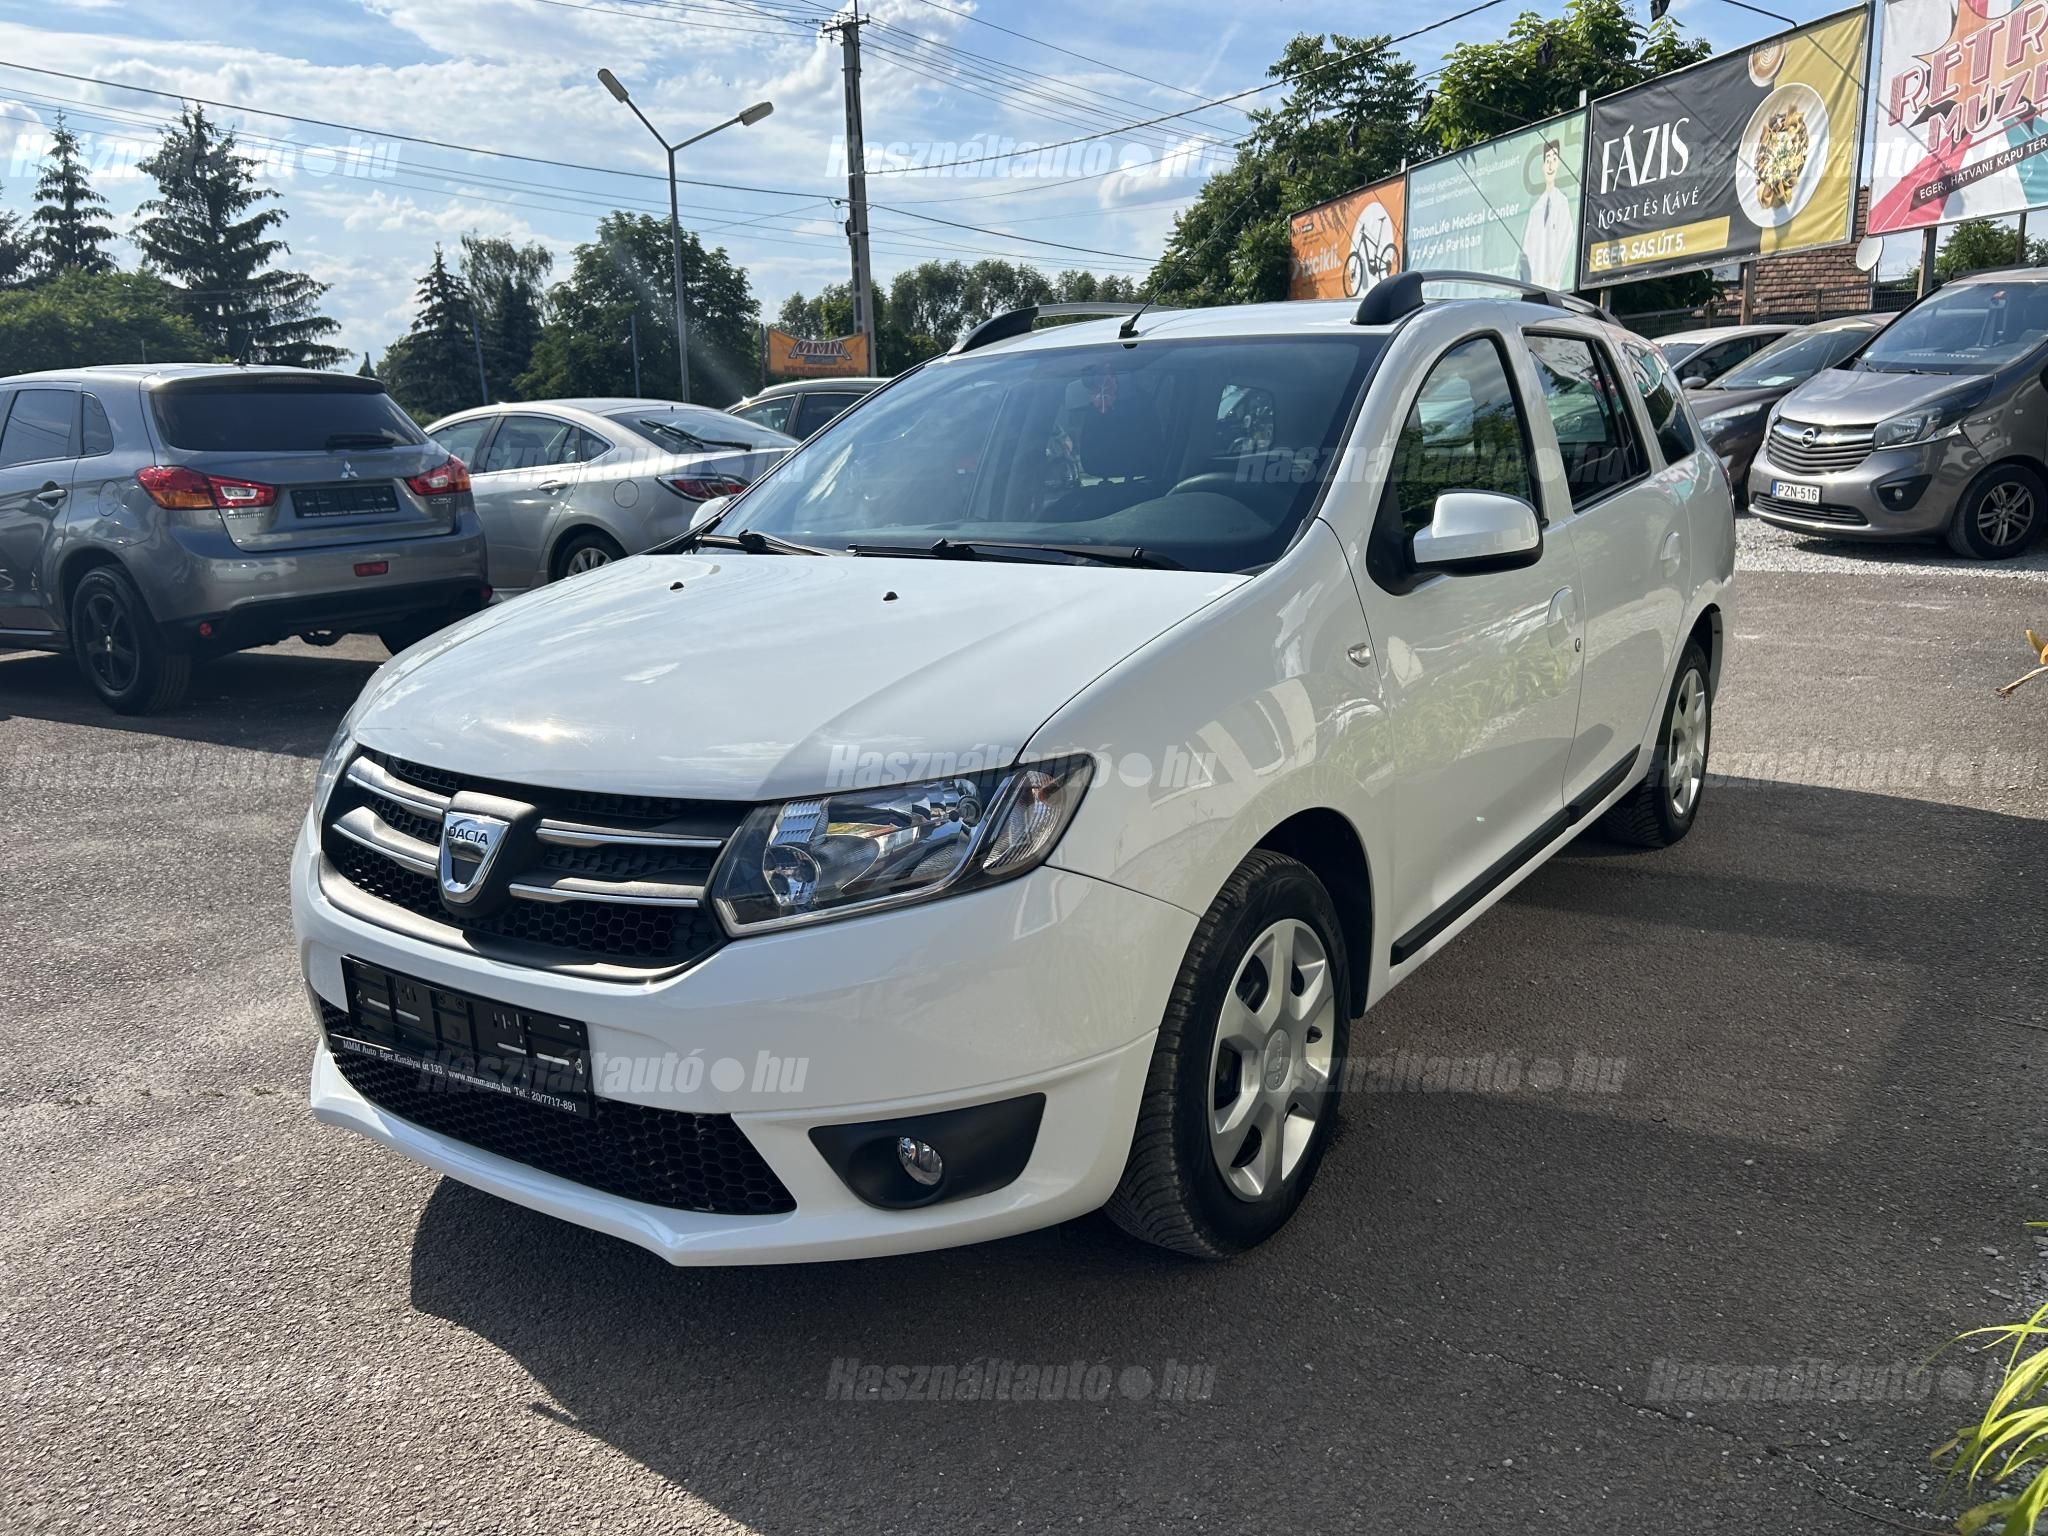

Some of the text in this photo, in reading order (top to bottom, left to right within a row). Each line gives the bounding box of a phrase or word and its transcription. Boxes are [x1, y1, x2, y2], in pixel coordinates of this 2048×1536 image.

[1600, 117, 1690, 195] FÁZIS
[1919, 180, 1947, 200] EGER,
[1950, 160, 1994, 186] HATVANI
[1996, 147, 2024, 167] KAPU
[1412, 202, 1520, 241] TritonLife Medical Center
[1598, 186, 1699, 230] KOSZT ÉS KÁVÉ
[1446, 234, 1481, 253] Parkban
[1595, 231, 1686, 267] EGER, SAS ÚT 5.
[788, 339, 852, 361] MMM
[1777, 484, 1818, 501] PZN-516
[448, 826, 489, 845] DACIA
[343, 1040, 361, 1052] MMM
[362, 1045, 377, 1057] Auto
[422, 1061, 430, 1071] út
[430, 1063, 446, 1076] 133.
[448, 1070, 512, 1094] www.mmmauto.hu
[531, 1091, 577, 1113] 20/7717-891
